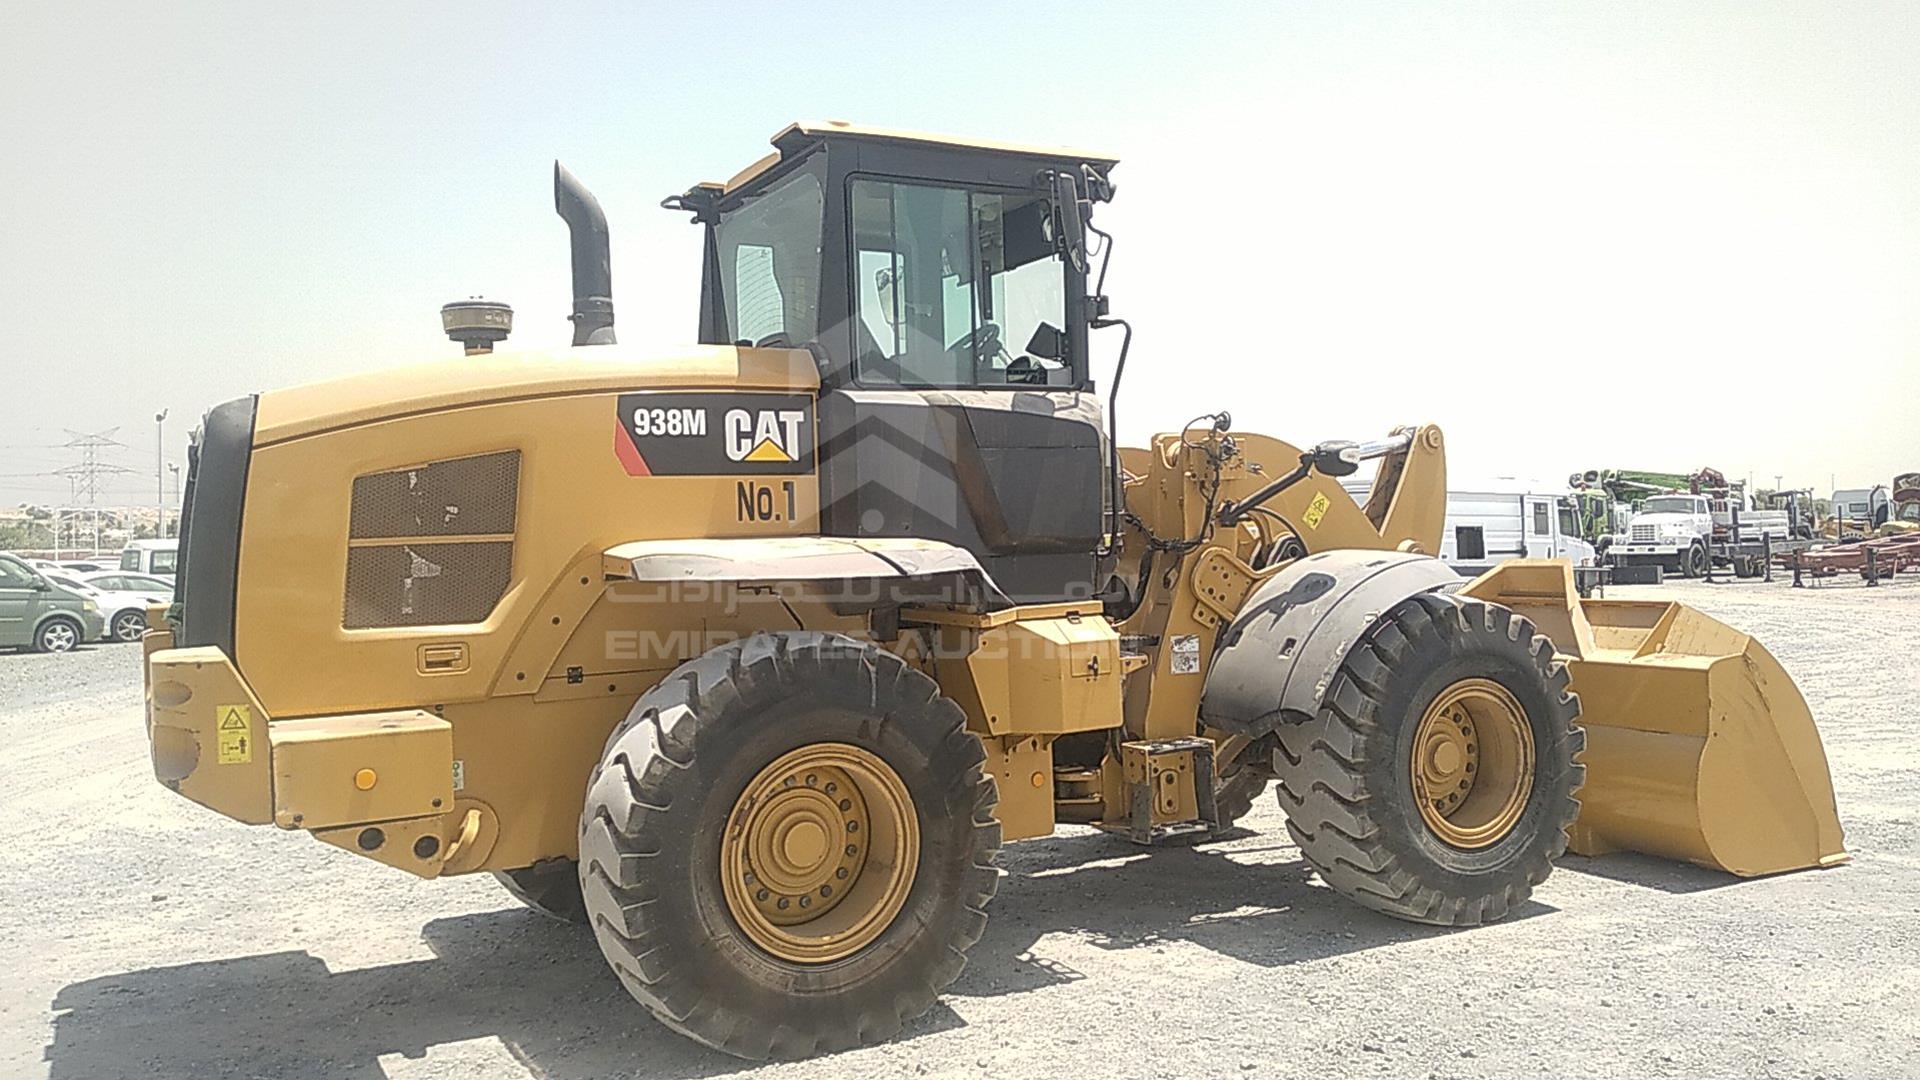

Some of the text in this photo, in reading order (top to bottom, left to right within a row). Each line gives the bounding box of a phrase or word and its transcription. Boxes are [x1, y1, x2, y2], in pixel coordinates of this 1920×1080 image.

[634, 408, 805, 462] 938M CAT
[737, 481, 796, 521] No.1
